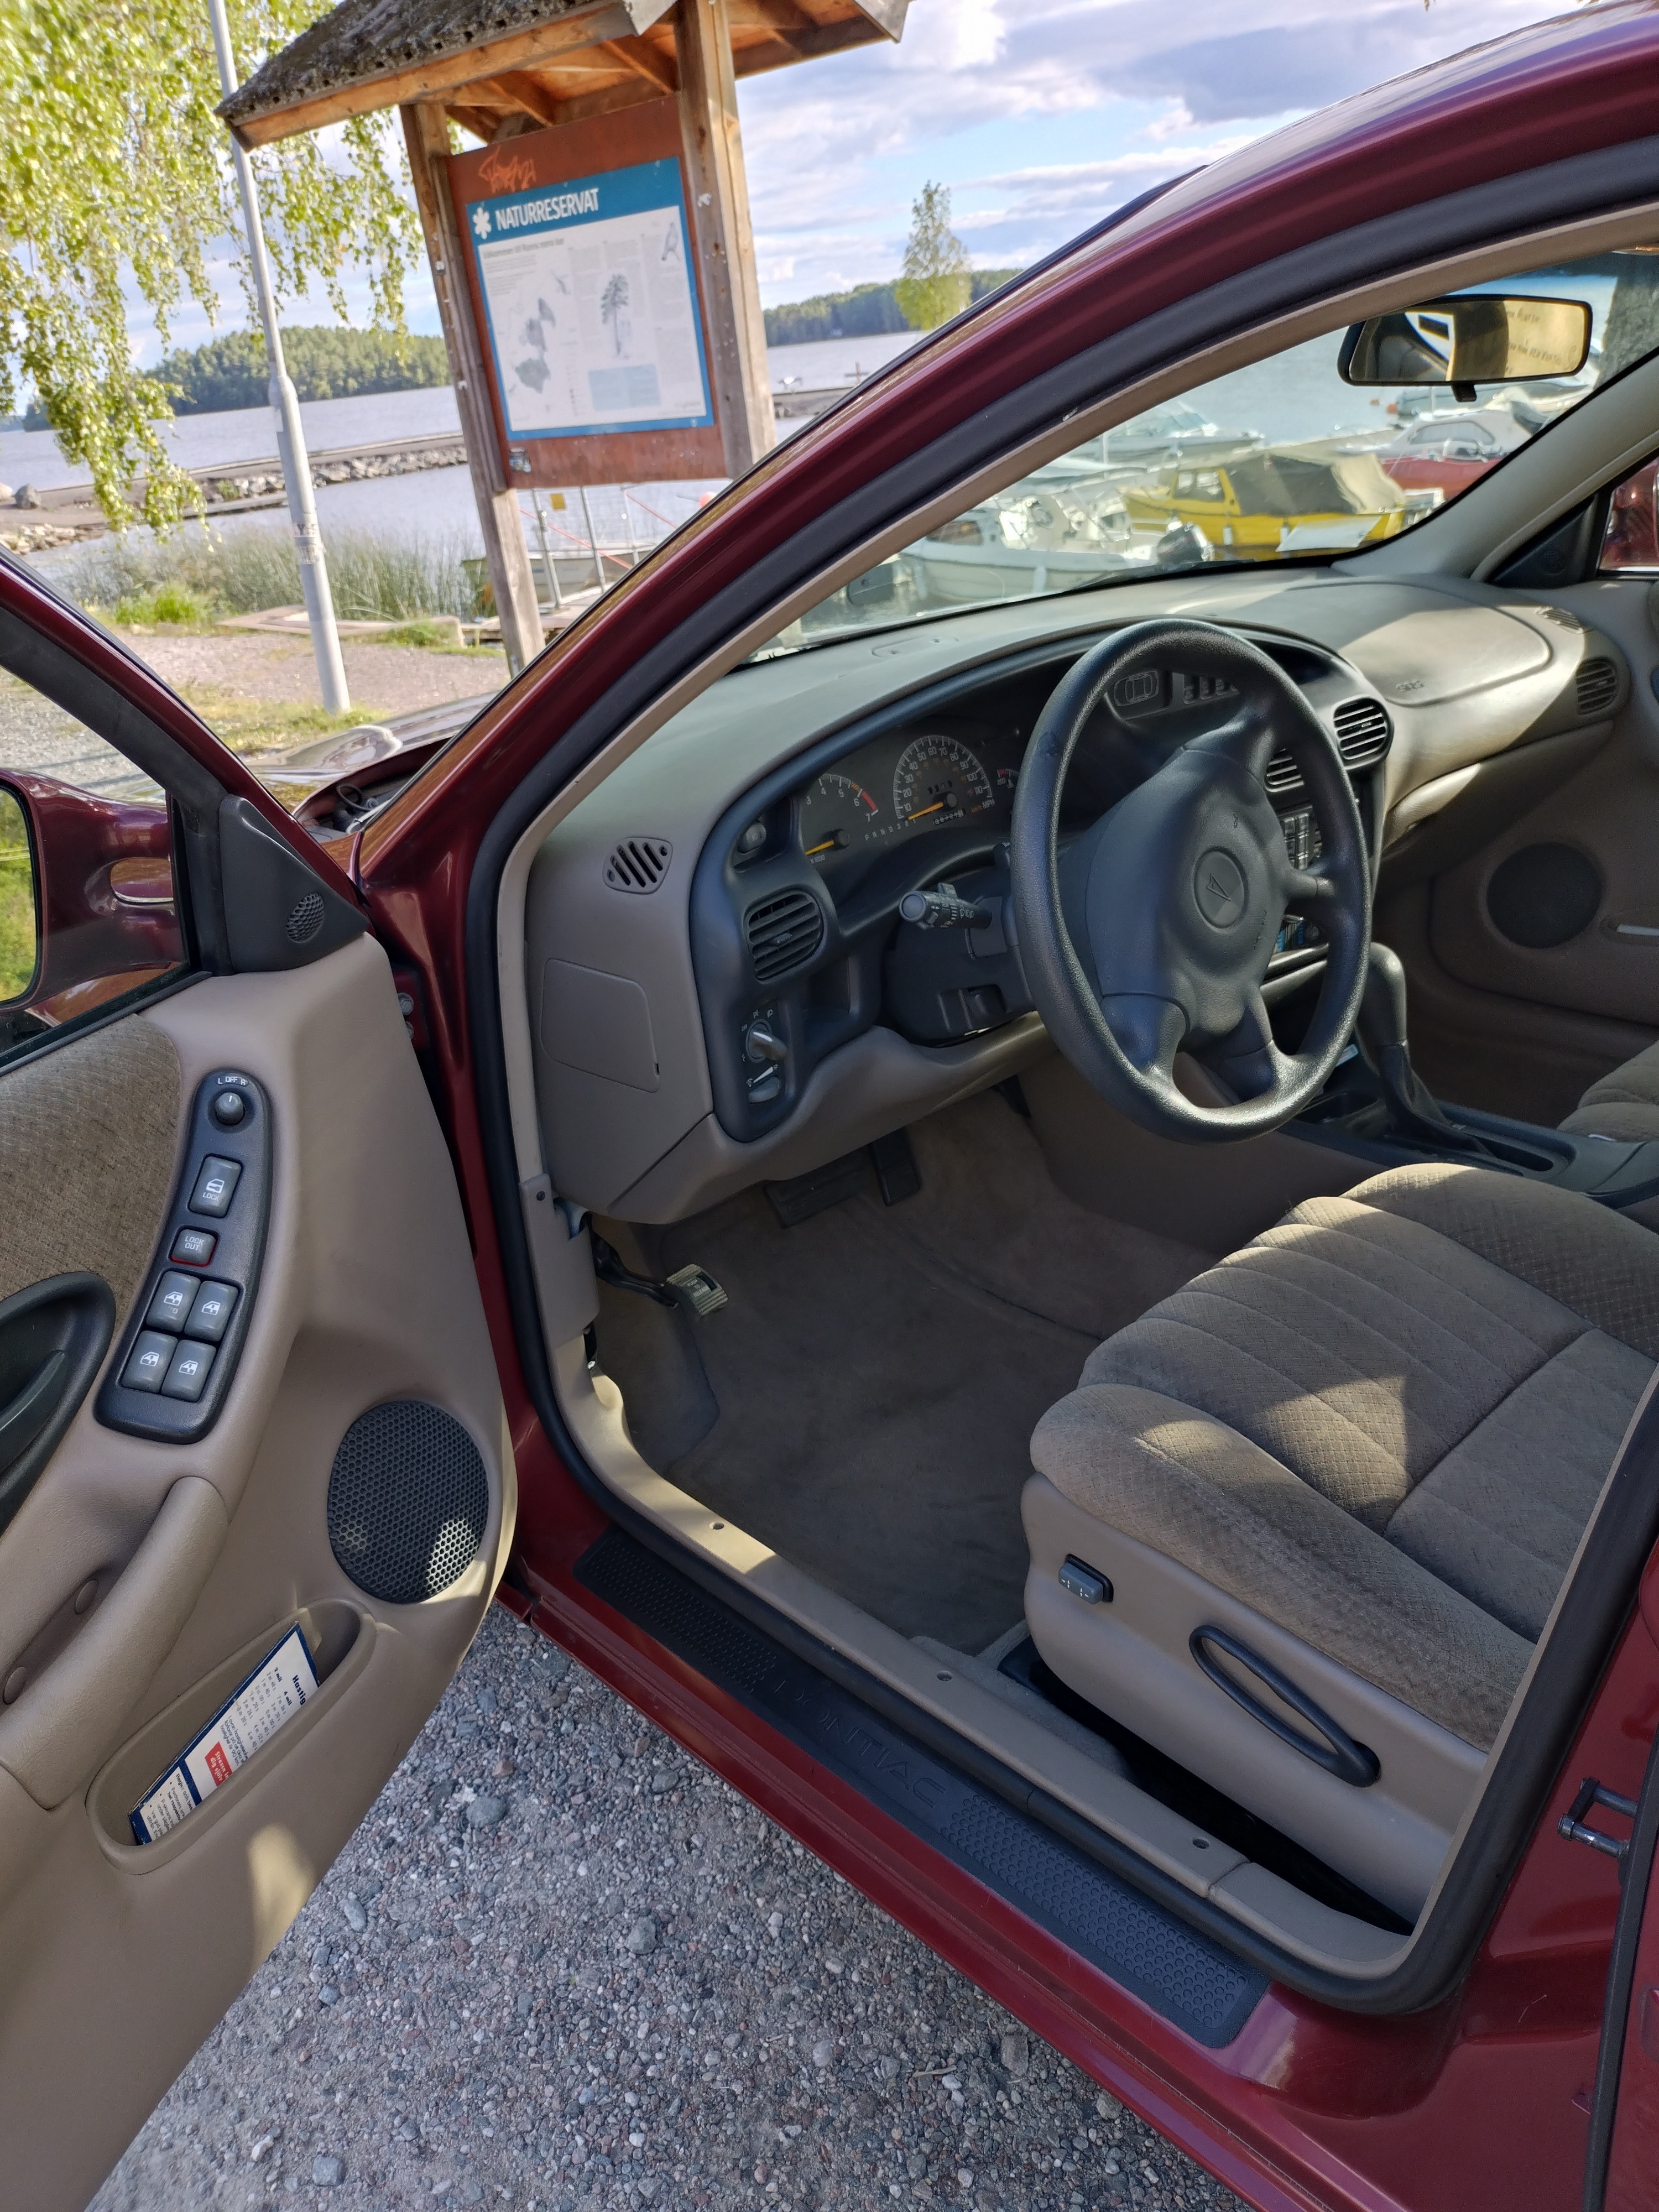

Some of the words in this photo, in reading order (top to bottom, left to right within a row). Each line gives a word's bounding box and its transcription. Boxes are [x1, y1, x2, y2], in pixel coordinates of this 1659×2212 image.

[495, 187, 599, 231] NATURRESERVAT
[927, 746, 937, 756] 60
[938, 747, 947, 757] 70
[917, 752, 927, 761] 50
[950, 752, 959, 761] 80
[909, 761, 919, 771] 40
[959, 760, 969, 770] 90
[904, 774, 914, 784] 30
[967, 772, 978, 782] 100
[821, 787, 826, 796] 4
[838, 789, 844, 798] 5
[902, 788, 912, 798] 20
[974, 785, 983, 795] 110
[806, 795, 812, 805] 3
[853, 797, 859, 807] 6
[982, 799, 995, 809] MPH
[904, 803, 912, 812] 10
[865, 813, 870, 822] 7
[202, 1192, 220, 1202] LOCK
[185, 1236, 205, 1246] LOCK
[184, 1242, 200, 1251] OUT
[293, 1675, 306, 1705] Hastig
[221, 1724, 231, 1744] hastighet
[215, 1751, 226, 1772] Stressa
